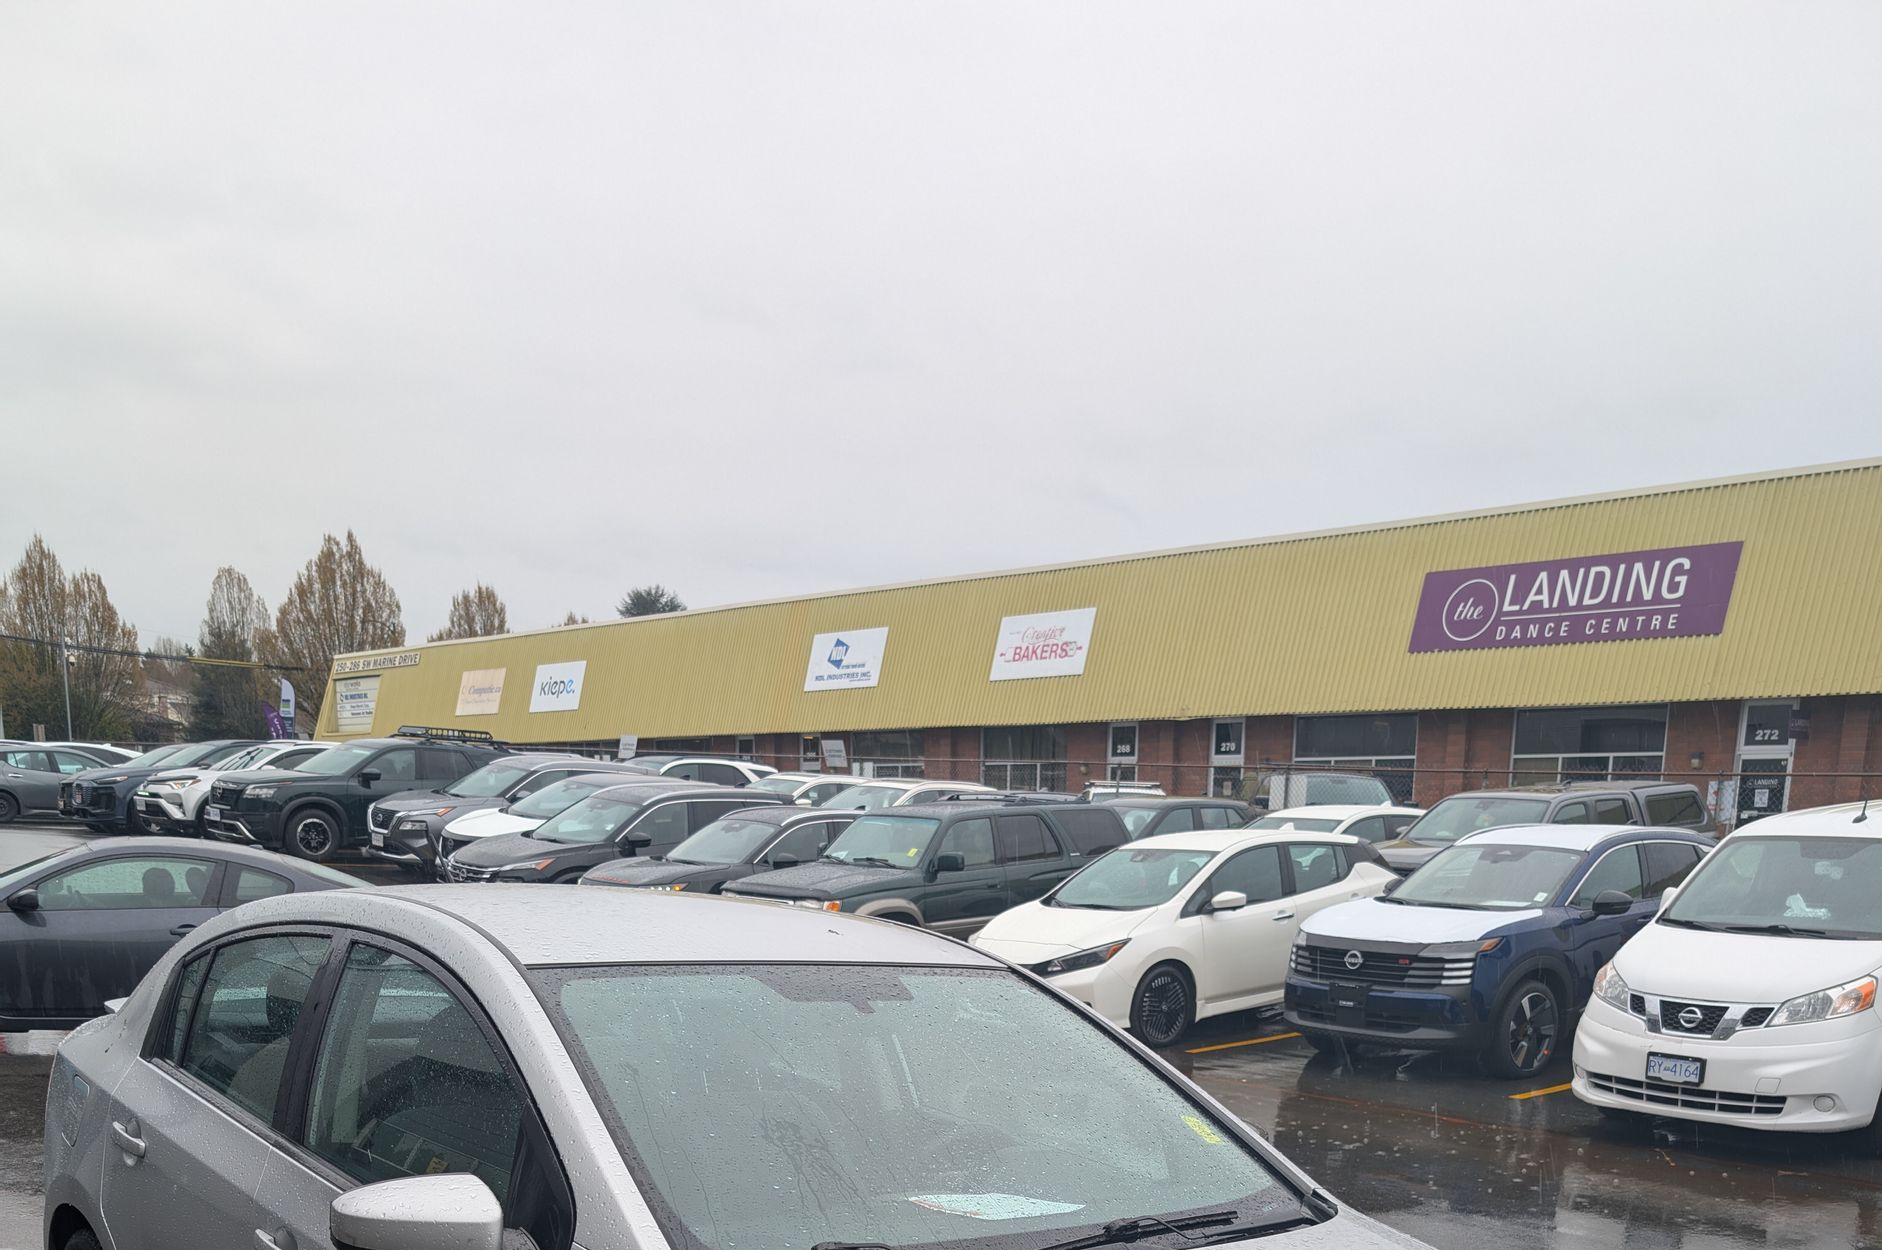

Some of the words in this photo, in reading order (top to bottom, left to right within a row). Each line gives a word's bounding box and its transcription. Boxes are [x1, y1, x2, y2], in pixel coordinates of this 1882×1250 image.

[1453, 597, 1484, 621] the
[1502, 557, 1691, 613] LANDING
[1495, 621, 1571, 640] DANCE
[1585, 614, 1680, 635] CENTRE
[1012, 641, 1069, 662] BAKERS
[361, 659, 372, 670] SW
[372, 656, 397, 667] MARINE
[398, 653, 419, 665] DRIVE
[826, 672, 860, 680] INDUSTRIES
[1754, 729, 1779, 740] 272
[1116, 744, 1131, 753] 268
[1220, 742, 1236, 751] 270
[1648, 1059, 1663, 1073] RY
[1670, 1063, 1699, 1079] 4164
